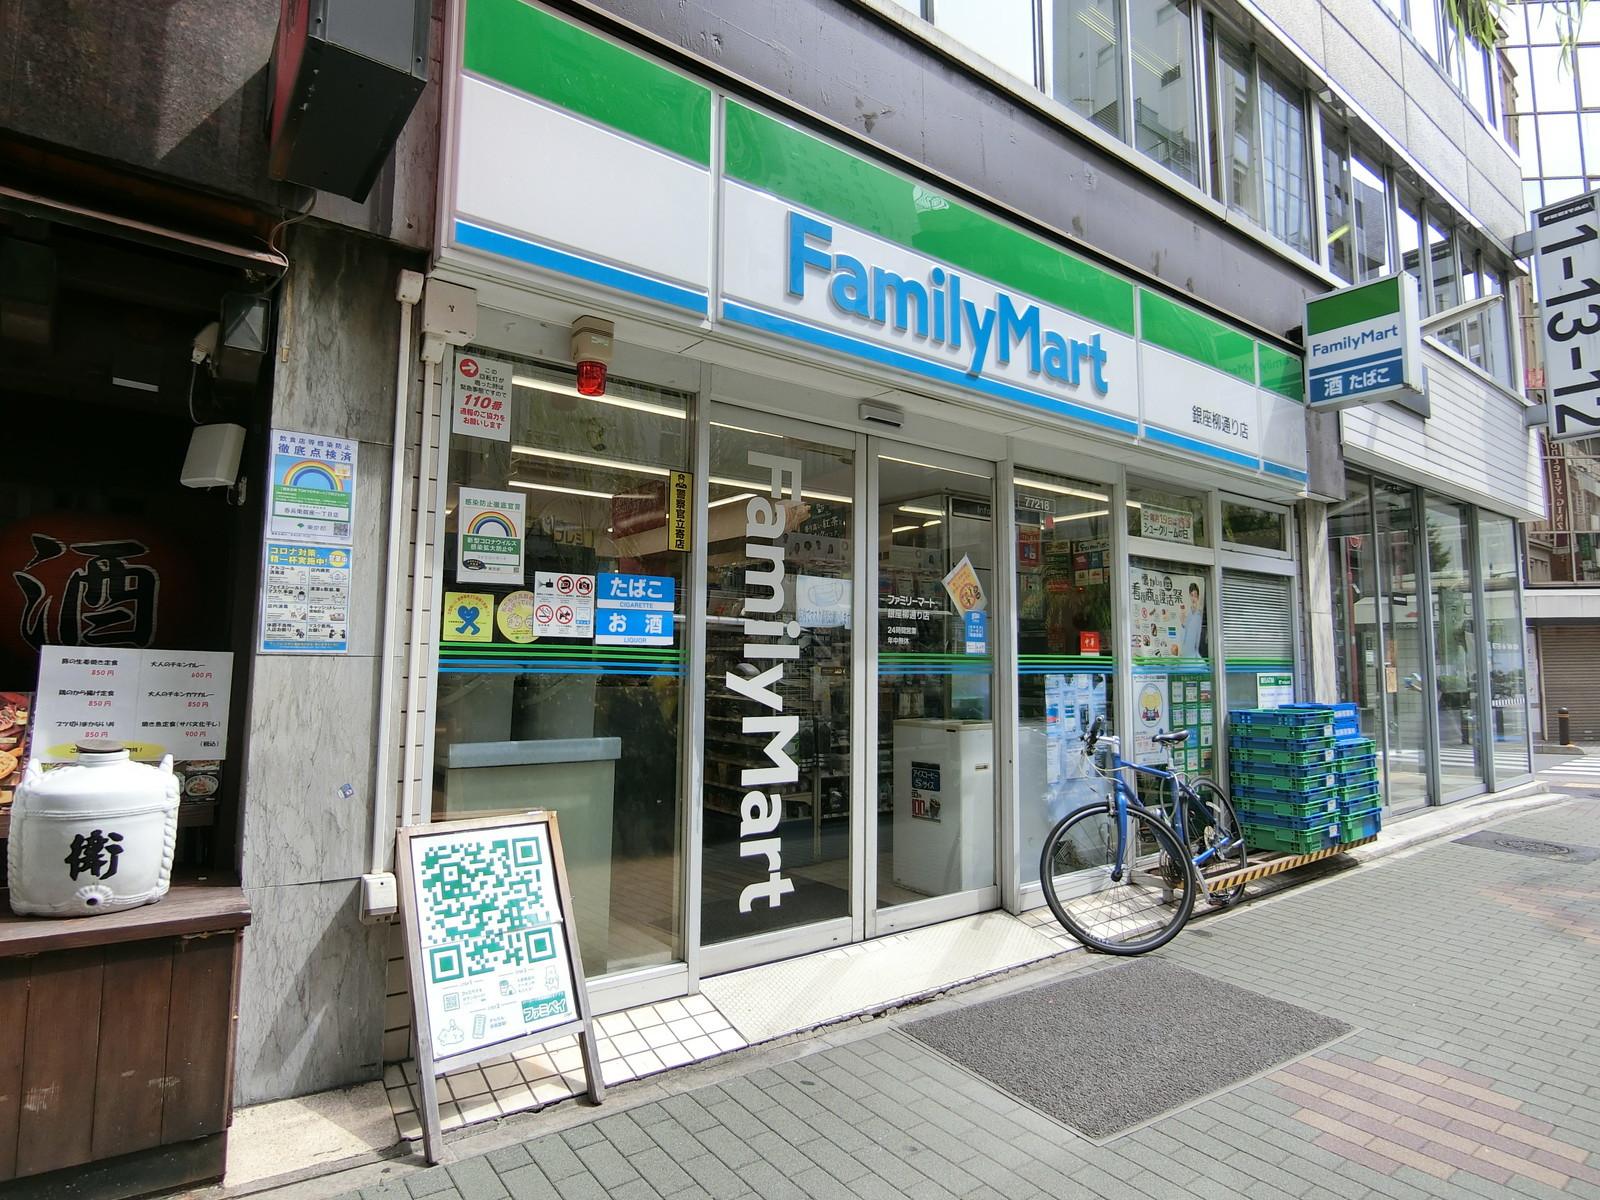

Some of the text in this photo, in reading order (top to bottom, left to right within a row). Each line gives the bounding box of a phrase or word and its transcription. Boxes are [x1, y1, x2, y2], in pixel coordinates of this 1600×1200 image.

[788, 209, 1108, 395] FamilyMart
[1541, 224, 1600, 435] 1-13-12
[1312, 324, 1398, 357] FamilyMart
[485, 367, 497, 375] この
[1324, 367, 1390, 397] 酒 たばこ
[464, 394, 503, 411] 110番
[460, 407, 506, 422] 通報のご協力を
[1191, 405, 1249, 440] 銀座柳通り店
[463, 417, 502, 430] お願いします
[279, 435, 351, 451] 飲食店等感染防止
[278, 443, 352, 461] 徹底点検済
[465, 498, 521, 511] 感染防止徹底宣言
[1024, 497, 1050, 511] 77218
[675, 489, 687, 550] 警察官立寄店
[467, 537, 517, 547] 新型コロナウイルス
[13, 533, 160, 650] 酒
[610, 577, 663, 599] たばこ
[619, 601, 653, 609] CIGARETTE
[887, 594, 936, 607] ファミリーマート
[887, 609, 930, 621] 銀座柳通り店
[887, 626, 917, 635] 24時間営業
[623, 636, 647, 644] LIQUOR
[887, 637, 910, 645] 年中無休
[725, 450, 802, 914] FamilyMart
[523, 998, 567, 1021] ファミペイ
